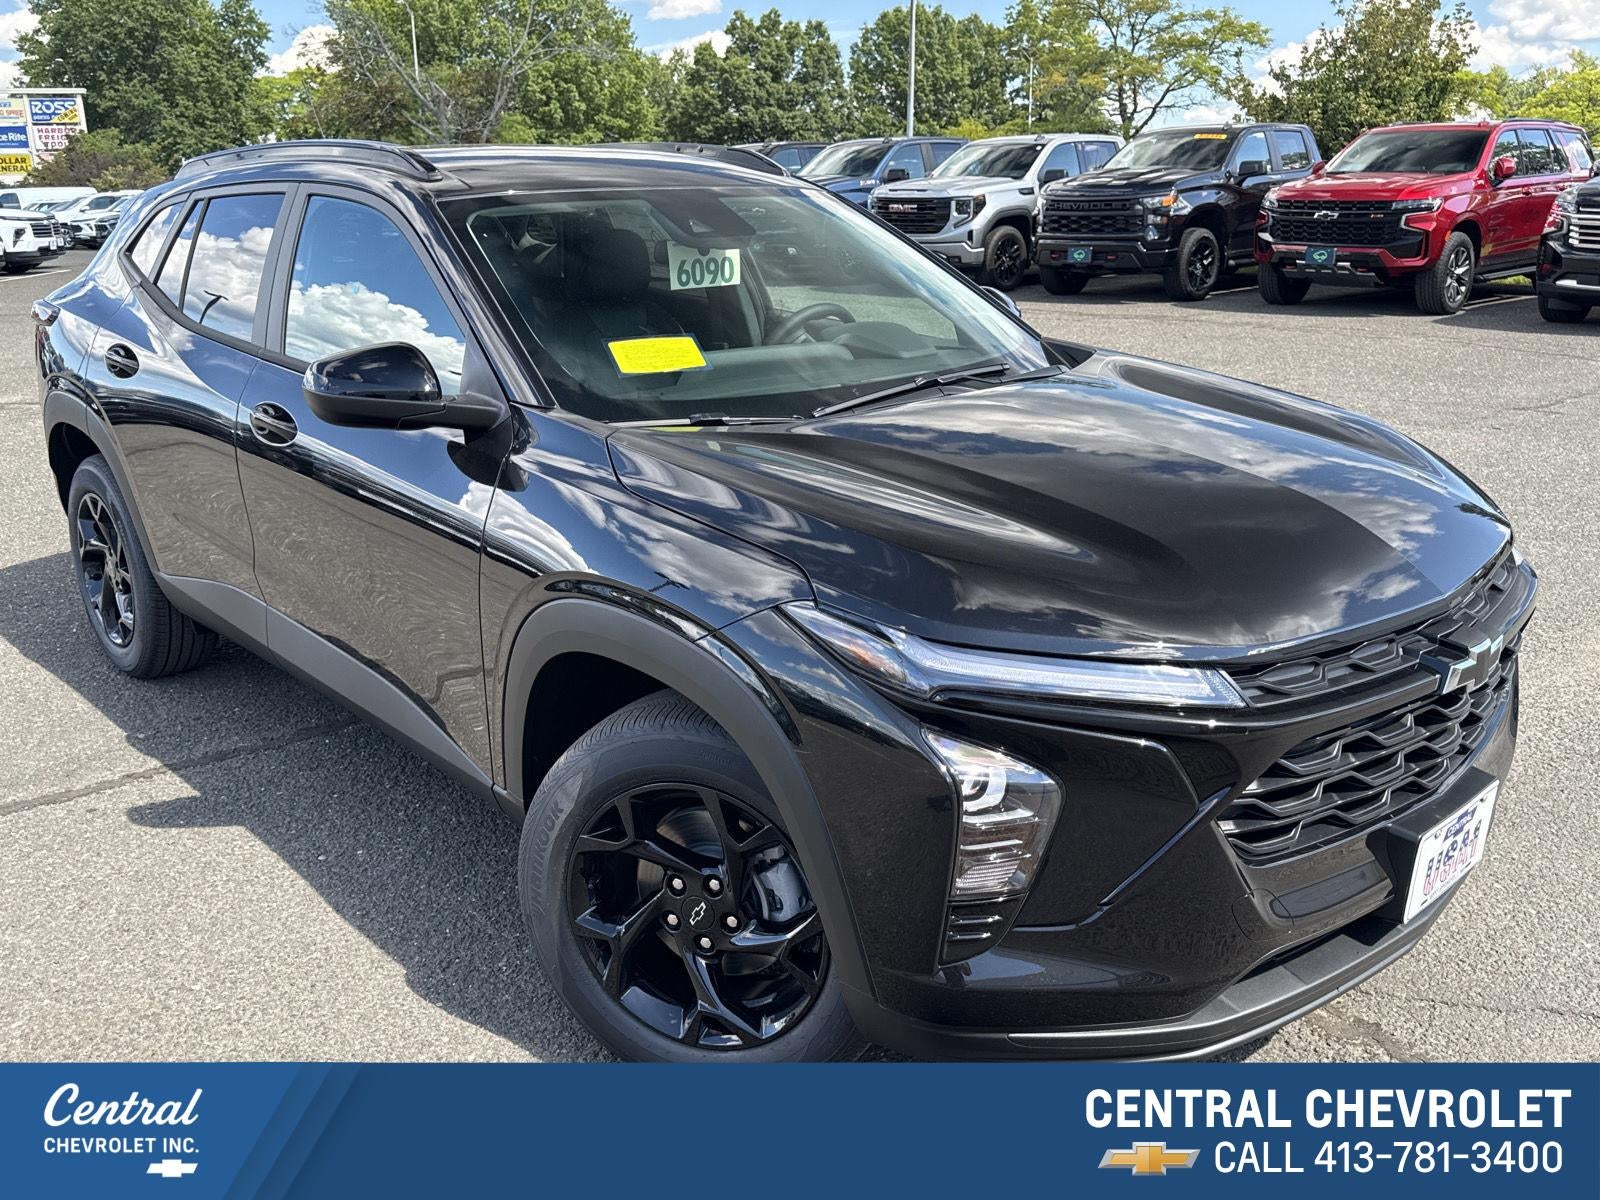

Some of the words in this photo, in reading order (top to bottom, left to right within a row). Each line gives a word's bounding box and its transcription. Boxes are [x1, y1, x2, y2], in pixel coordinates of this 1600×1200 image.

[31, 101, 75, 114] ROSS
[888, 204, 918, 213] GMC
[676, 256, 735, 287] 6090
